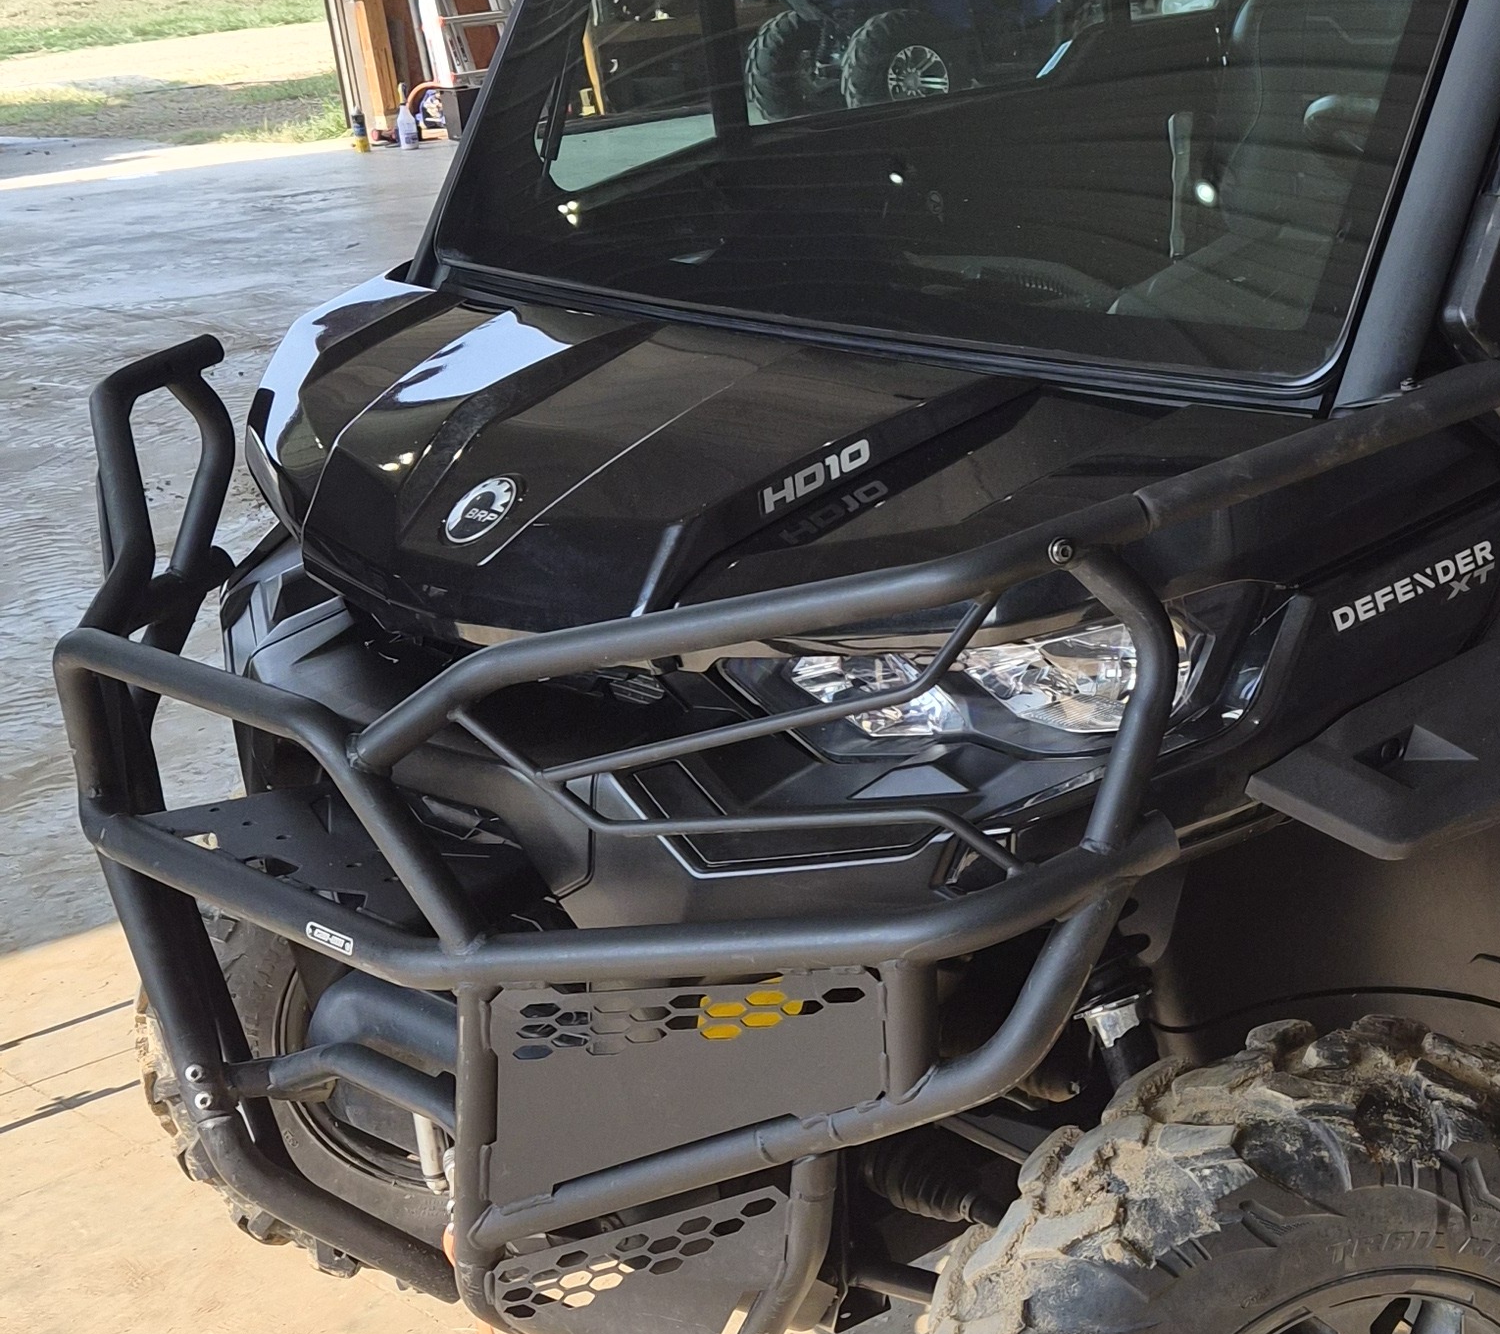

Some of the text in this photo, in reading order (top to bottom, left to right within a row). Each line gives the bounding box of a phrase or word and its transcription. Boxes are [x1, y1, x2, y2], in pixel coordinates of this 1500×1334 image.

[762, 438, 870, 514] HD10
[464, 508, 499, 523] BRP
[1331, 540, 1495, 633] DEFENDER
[1446, 562, 1496, 601] XT
